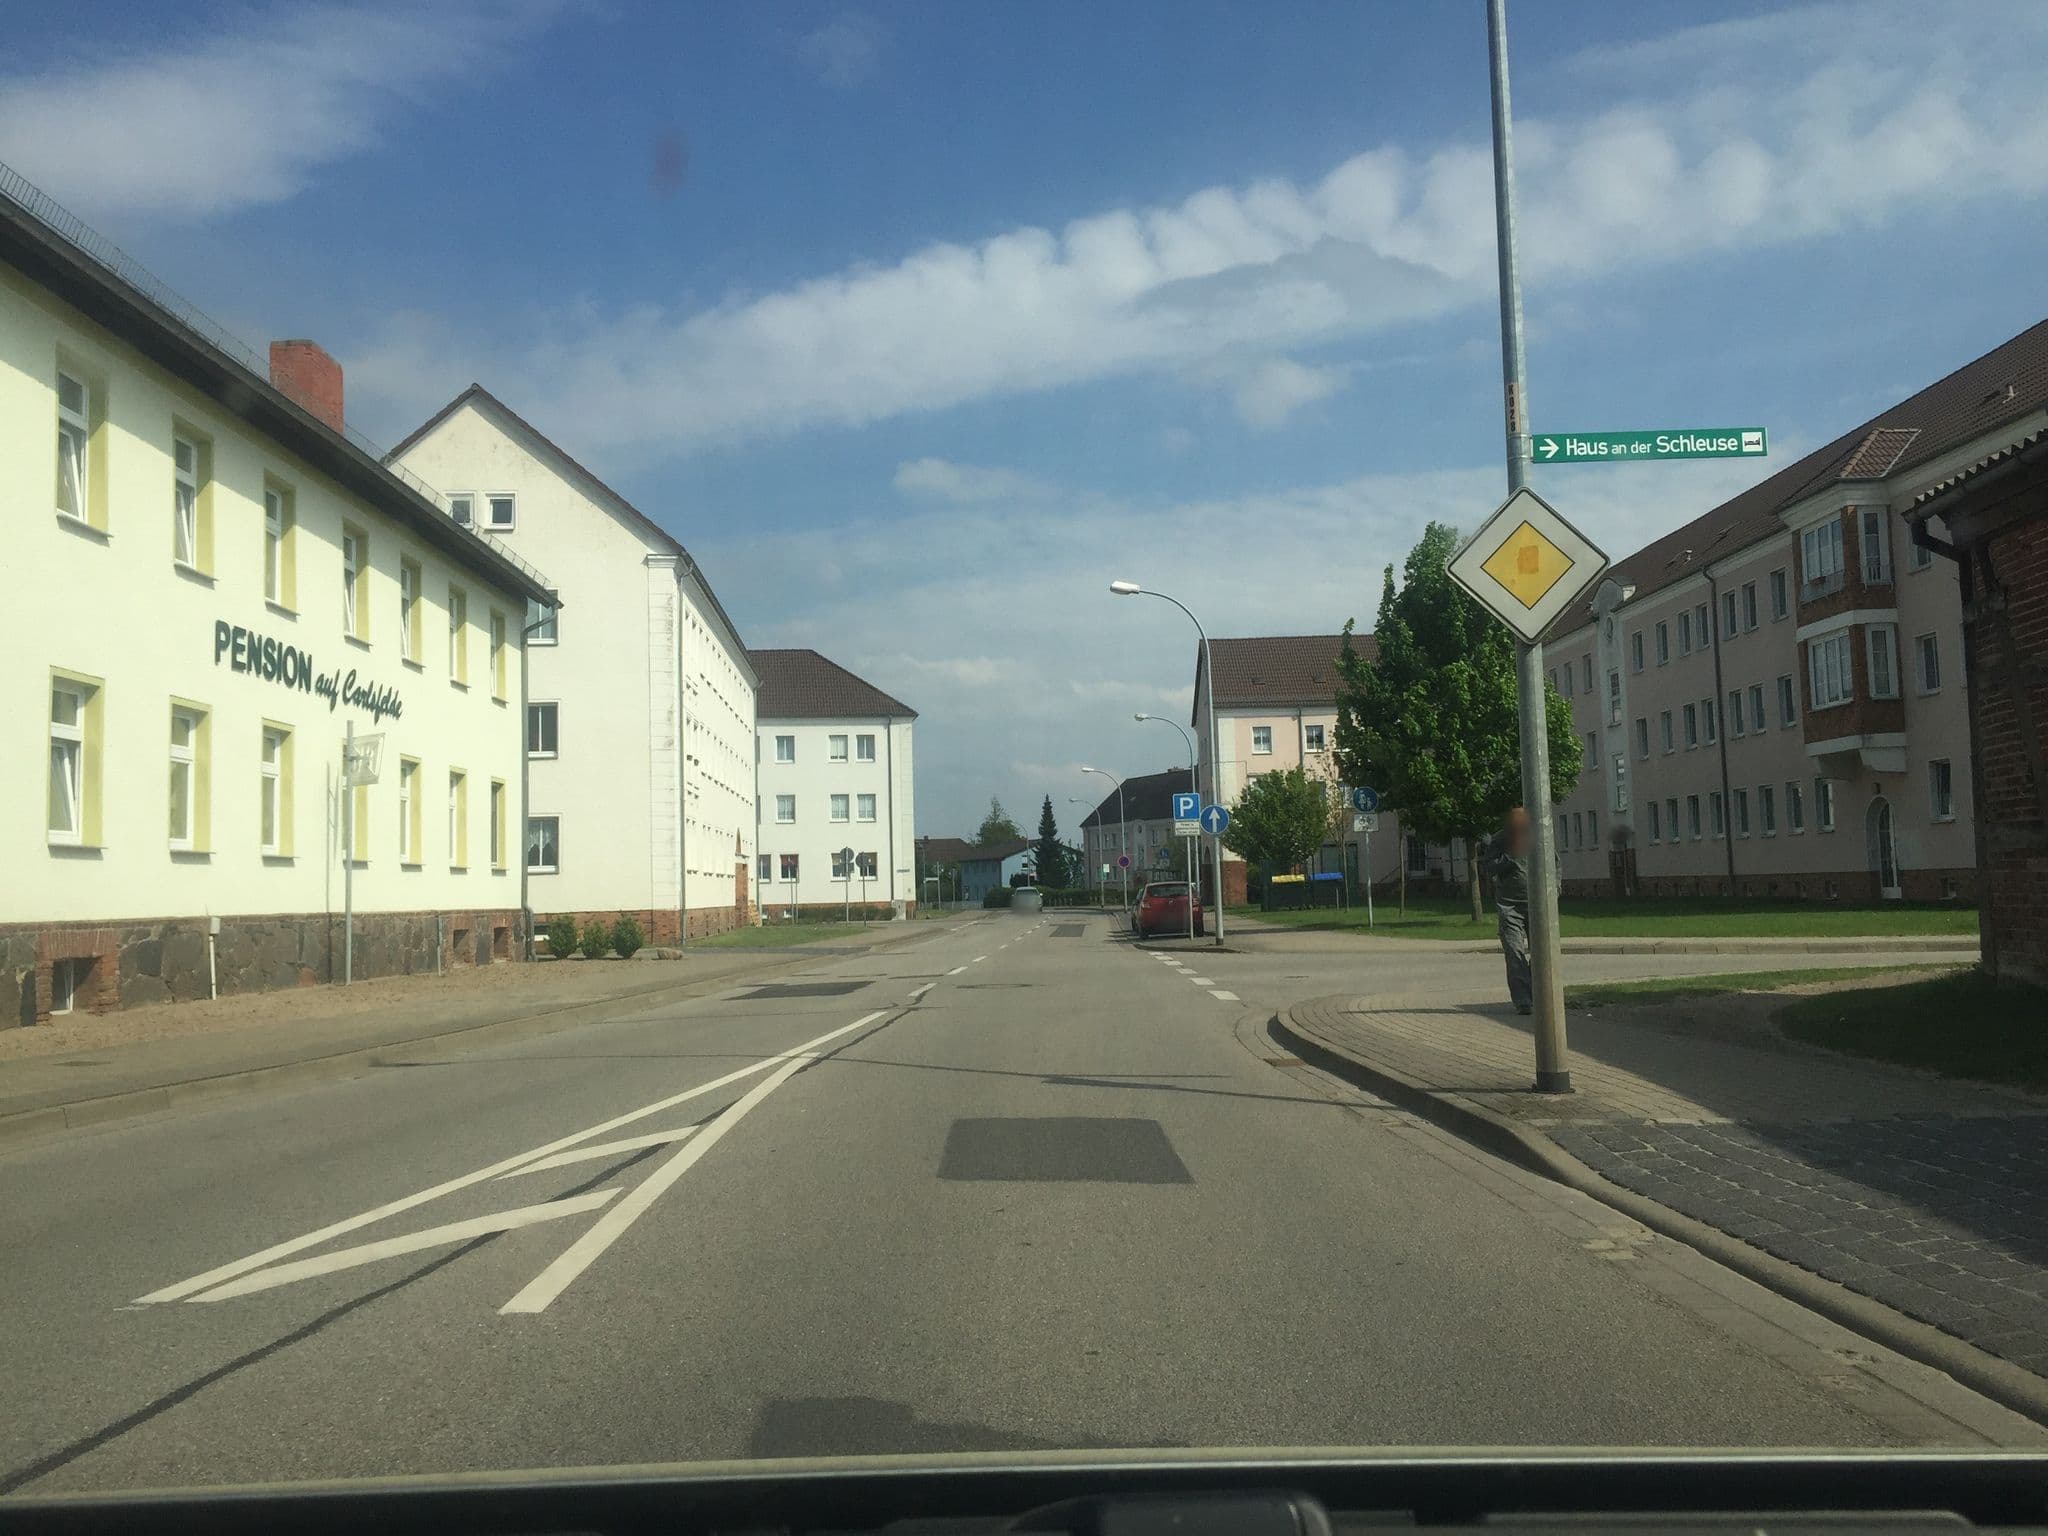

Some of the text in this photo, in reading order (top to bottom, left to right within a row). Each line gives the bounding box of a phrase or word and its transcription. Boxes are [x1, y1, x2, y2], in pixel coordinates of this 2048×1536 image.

[1566, 434, 1738, 457] Haus an der Schleuse
[215, 619, 312, 695] PENSION
[314, 668, 340, 713] auf
[1179, 797, 1194, 817] P
